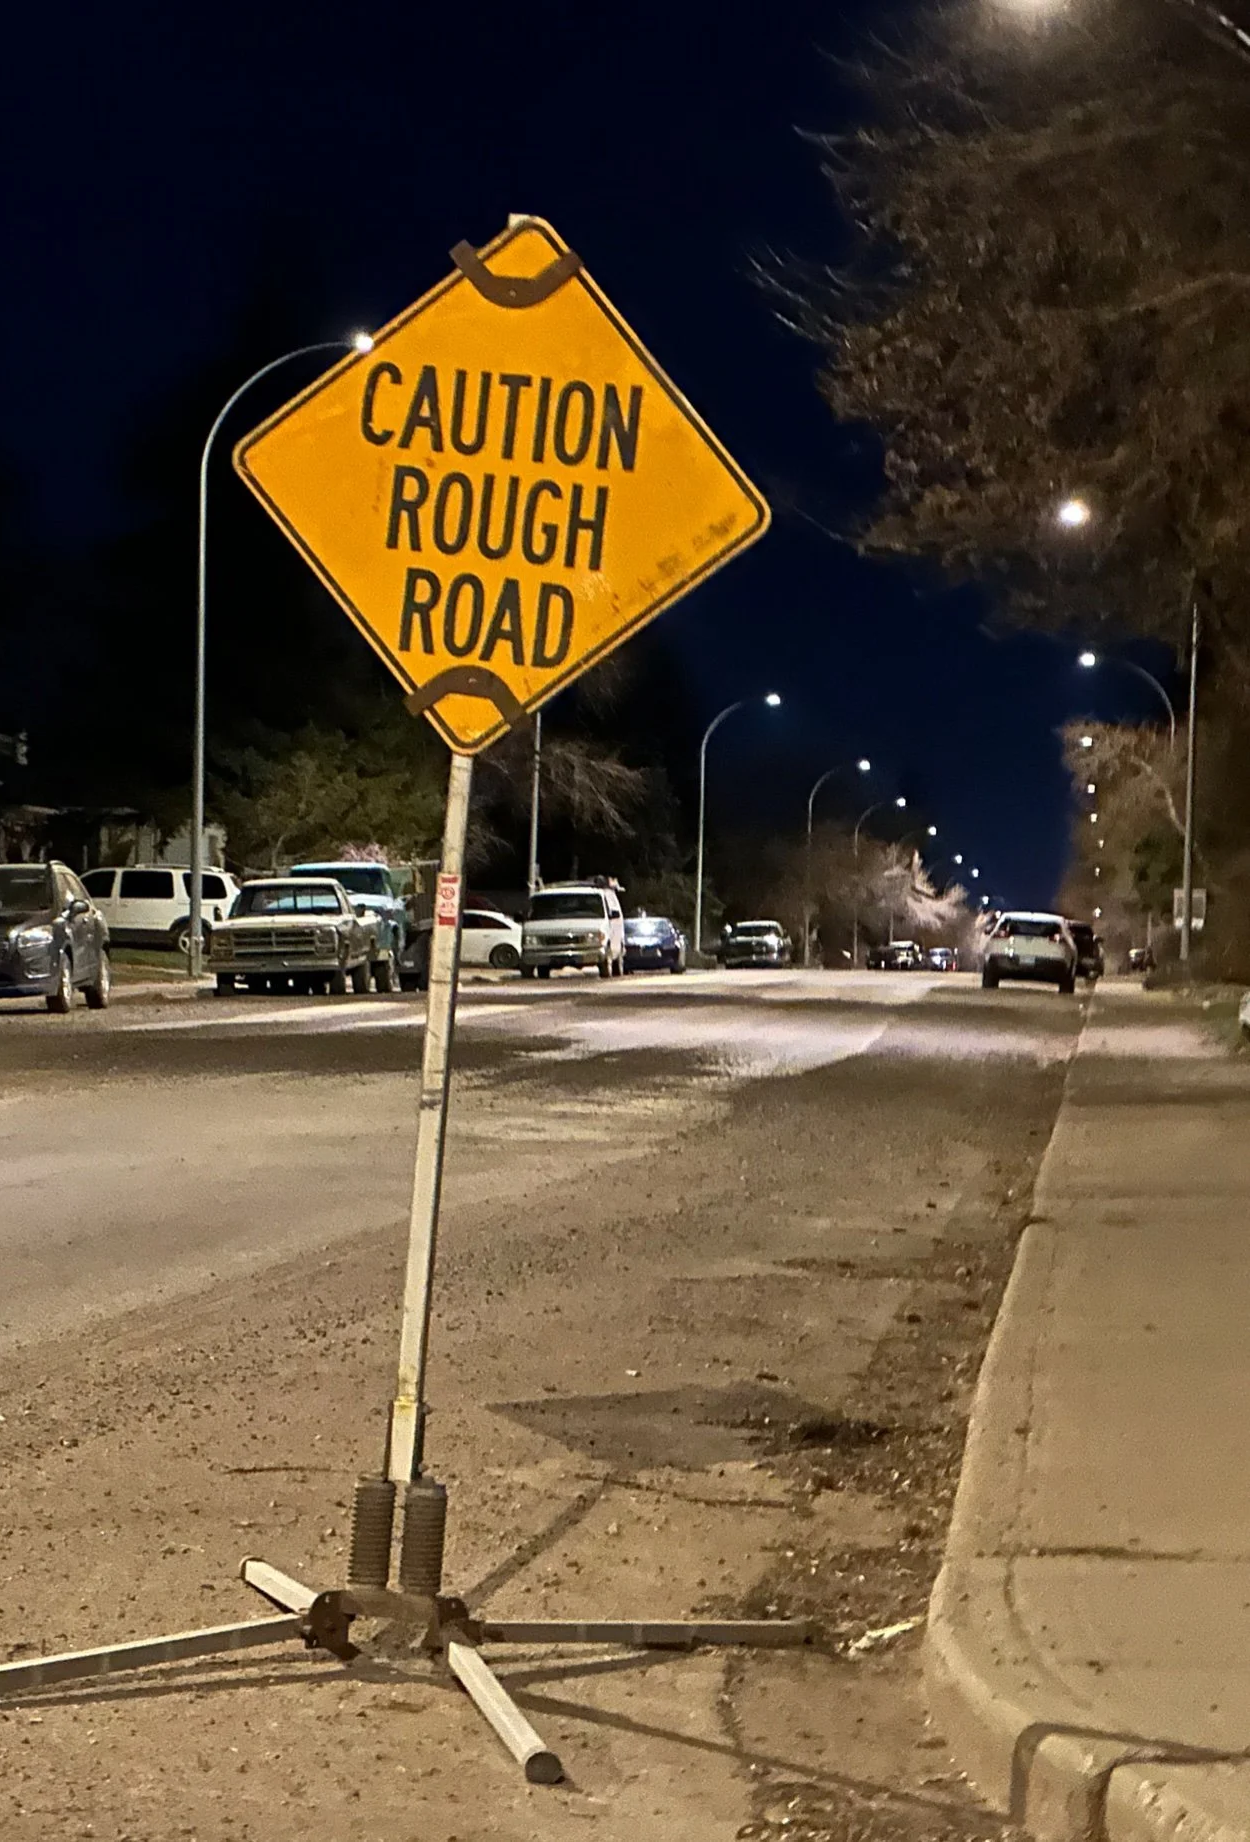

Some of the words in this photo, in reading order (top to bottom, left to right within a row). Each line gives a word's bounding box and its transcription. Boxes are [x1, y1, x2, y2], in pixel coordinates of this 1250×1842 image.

[361, 361, 643, 472] CAUTION
[386, 464, 609, 571] ROUGH
[398, 567, 575, 669] ROAD
